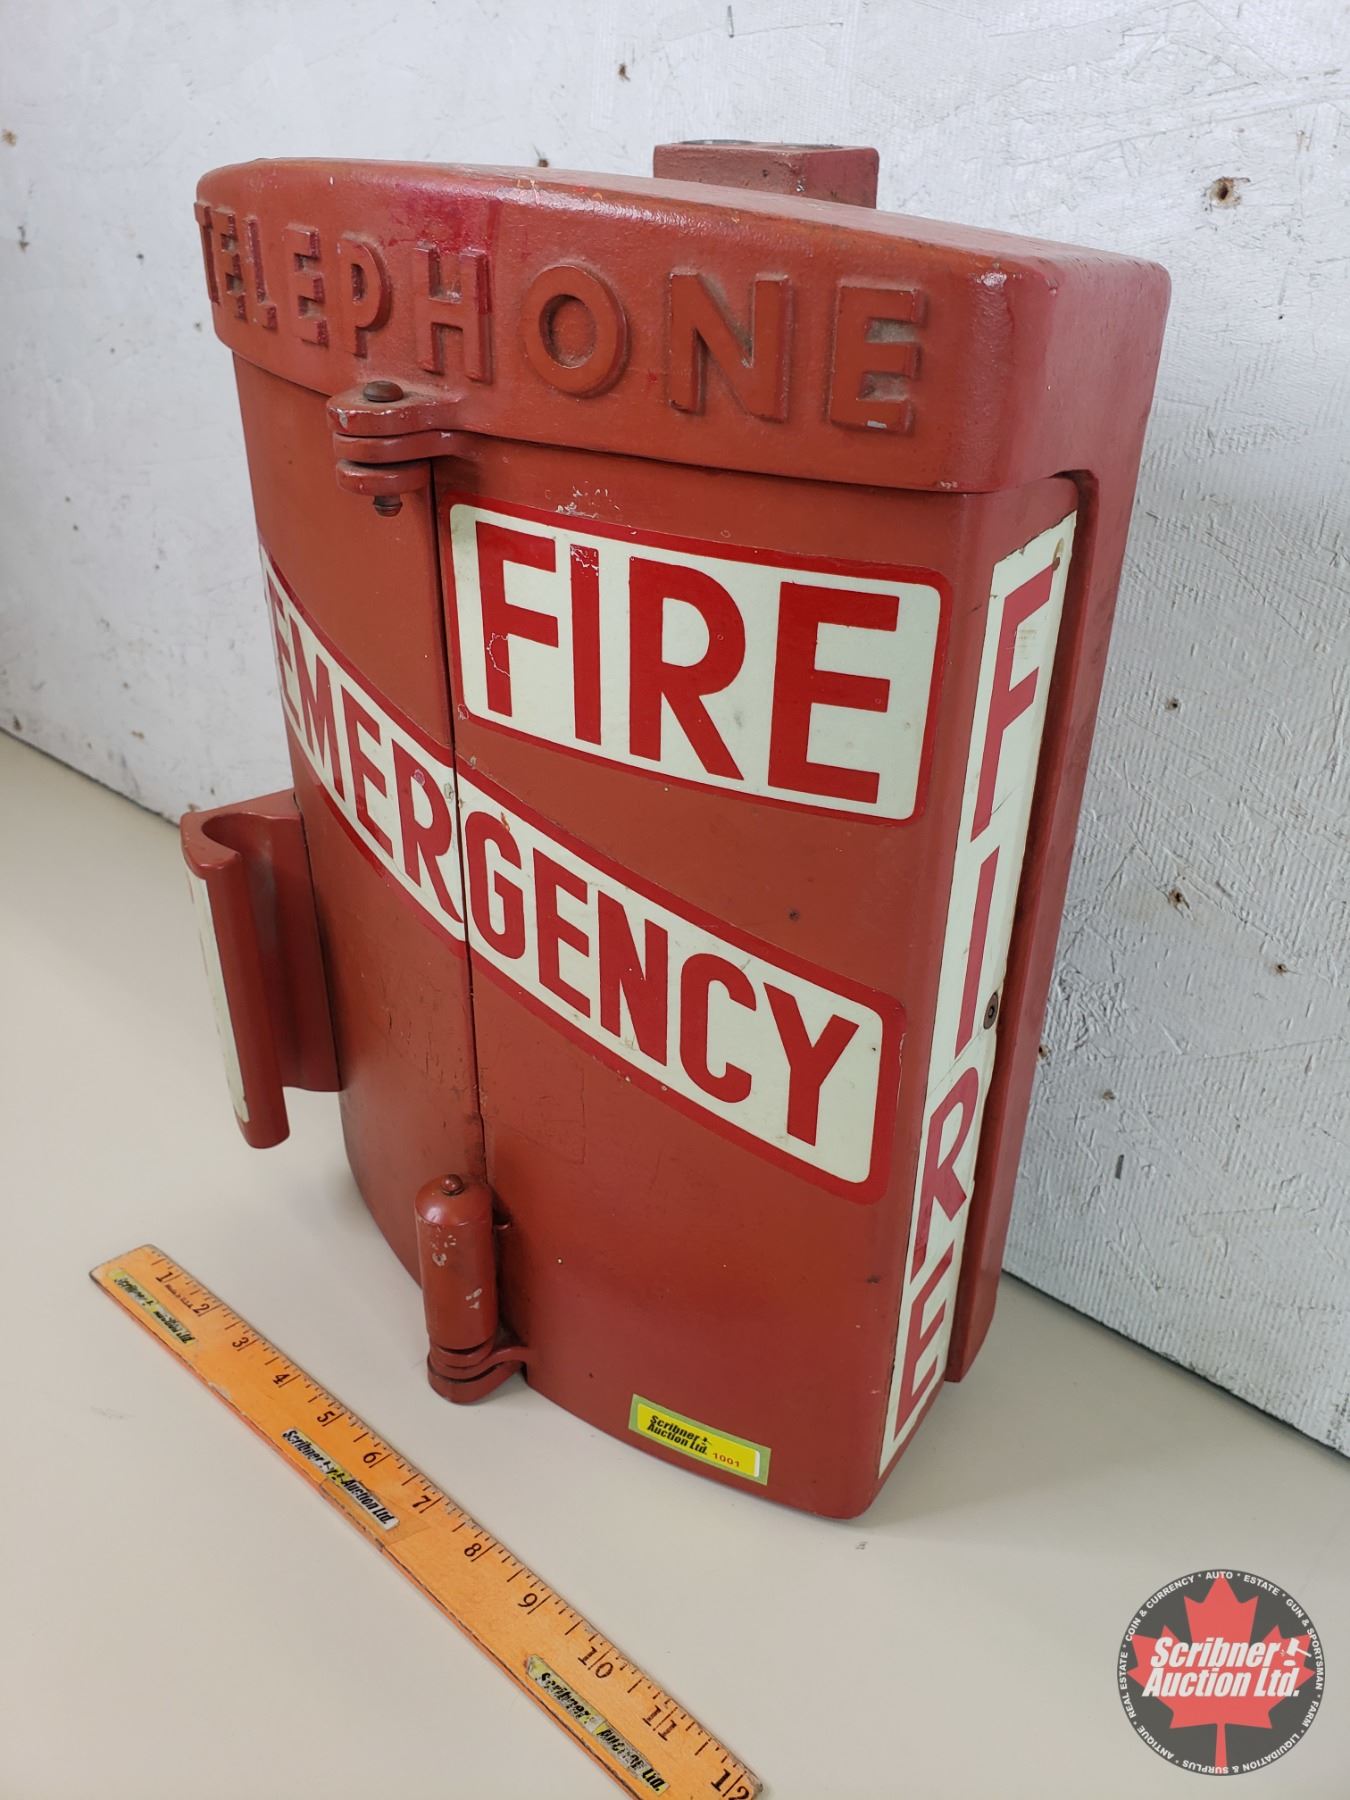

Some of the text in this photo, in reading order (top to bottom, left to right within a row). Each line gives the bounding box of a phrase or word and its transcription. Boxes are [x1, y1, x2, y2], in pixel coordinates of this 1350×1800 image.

[193, 201, 926, 434] TELEPHONE
[476, 520, 901, 804] FIRE
[266, 567, 860, 1147] EMERGENCY
[894, 562, 1053, 1441] FIRE
[155, 1271, 173, 1282] 1
[192, 1303, 210, 1314] 2
[232, 1336, 249, 1349] 3
[272, 1372, 290, 1385] 4
[316, 1410, 335, 1423] 5
[650, 1415, 700, 1443] Scribner
[647, 1423, 708, 1456] Auction Ltd.
[363, 1451, 382, 1464] 6
[712, 1451, 741, 1467] 1001
[282, 1430, 325, 1461] Scribner
[343, 1479, 380, 1511] Auction
[412, 1495, 431, 1508] 7
[464, 1542, 482, 1558] 8
[518, 1592, 538, 1608] 9
[577, 1646, 614, 1679] 10
[642, 1705, 677, 1741] 11
